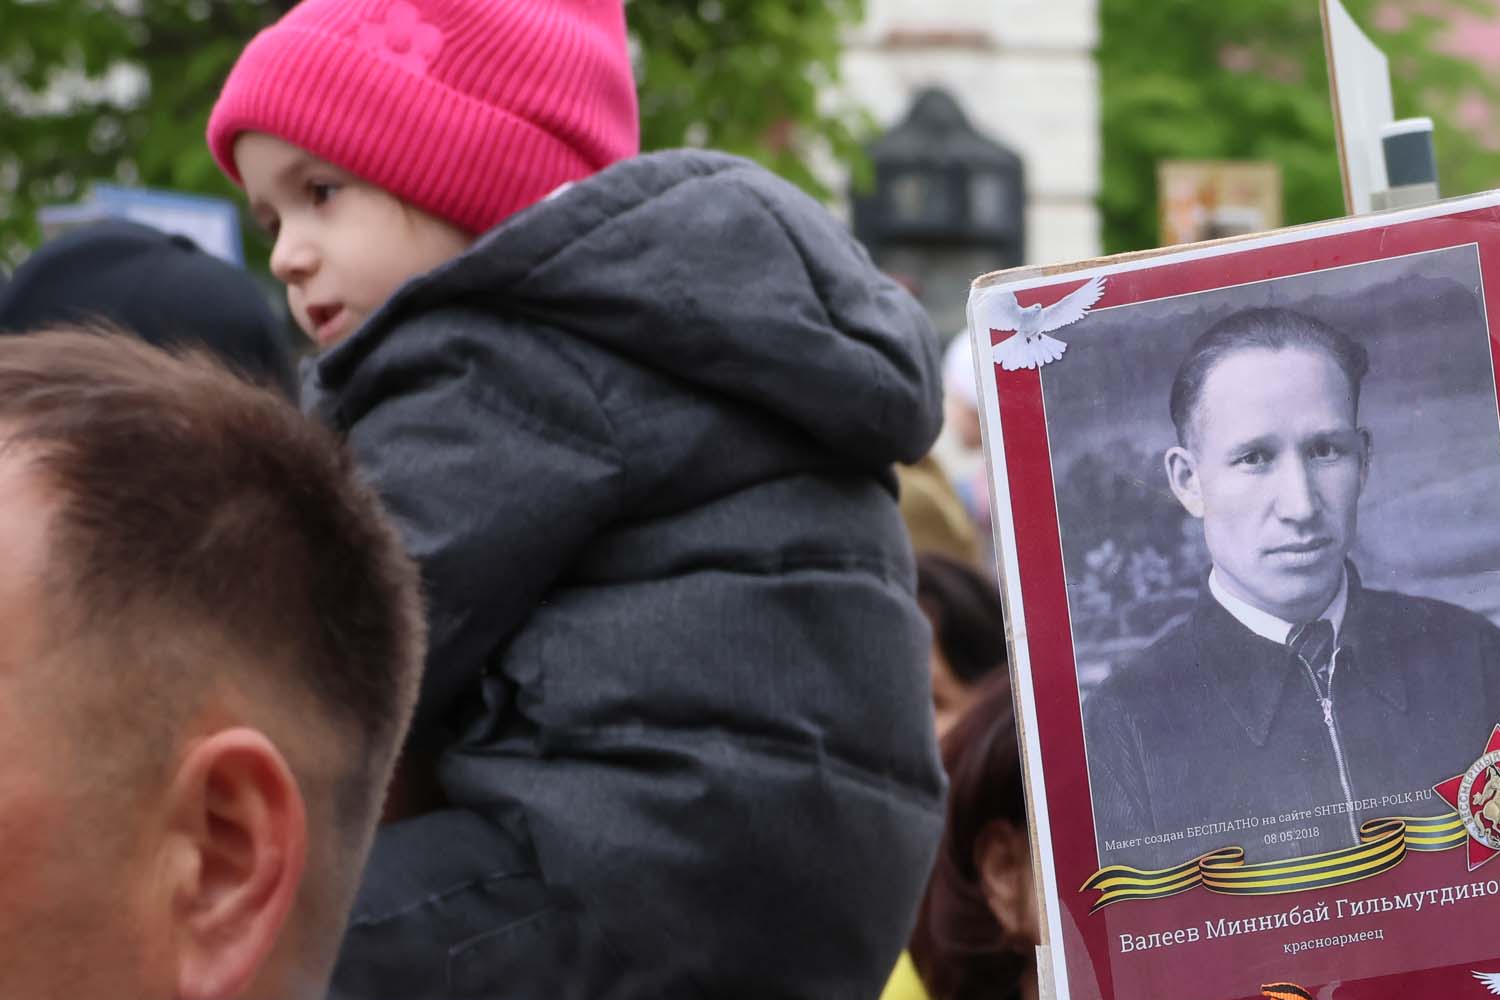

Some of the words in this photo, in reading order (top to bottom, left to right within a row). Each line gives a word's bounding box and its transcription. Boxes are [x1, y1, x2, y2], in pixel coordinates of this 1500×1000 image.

[1104, 837, 1142, 852] Макет
[1144, 831, 1184, 846] создан
[1186, 816, 1259, 838] БЕСПЛАТНО
[1262, 816, 1276, 827] на
[1279, 809, 1312, 824] сайте
[1314, 788, 1433, 818] SHTENDER-POLK.RU
[1263, 826, 1320, 845] 08.05.2018
[1119, 927, 1200, 953] Валеев
[1205, 903, 1330, 940] Миннибай
[1283, 928, 1384, 955] красноармеец
